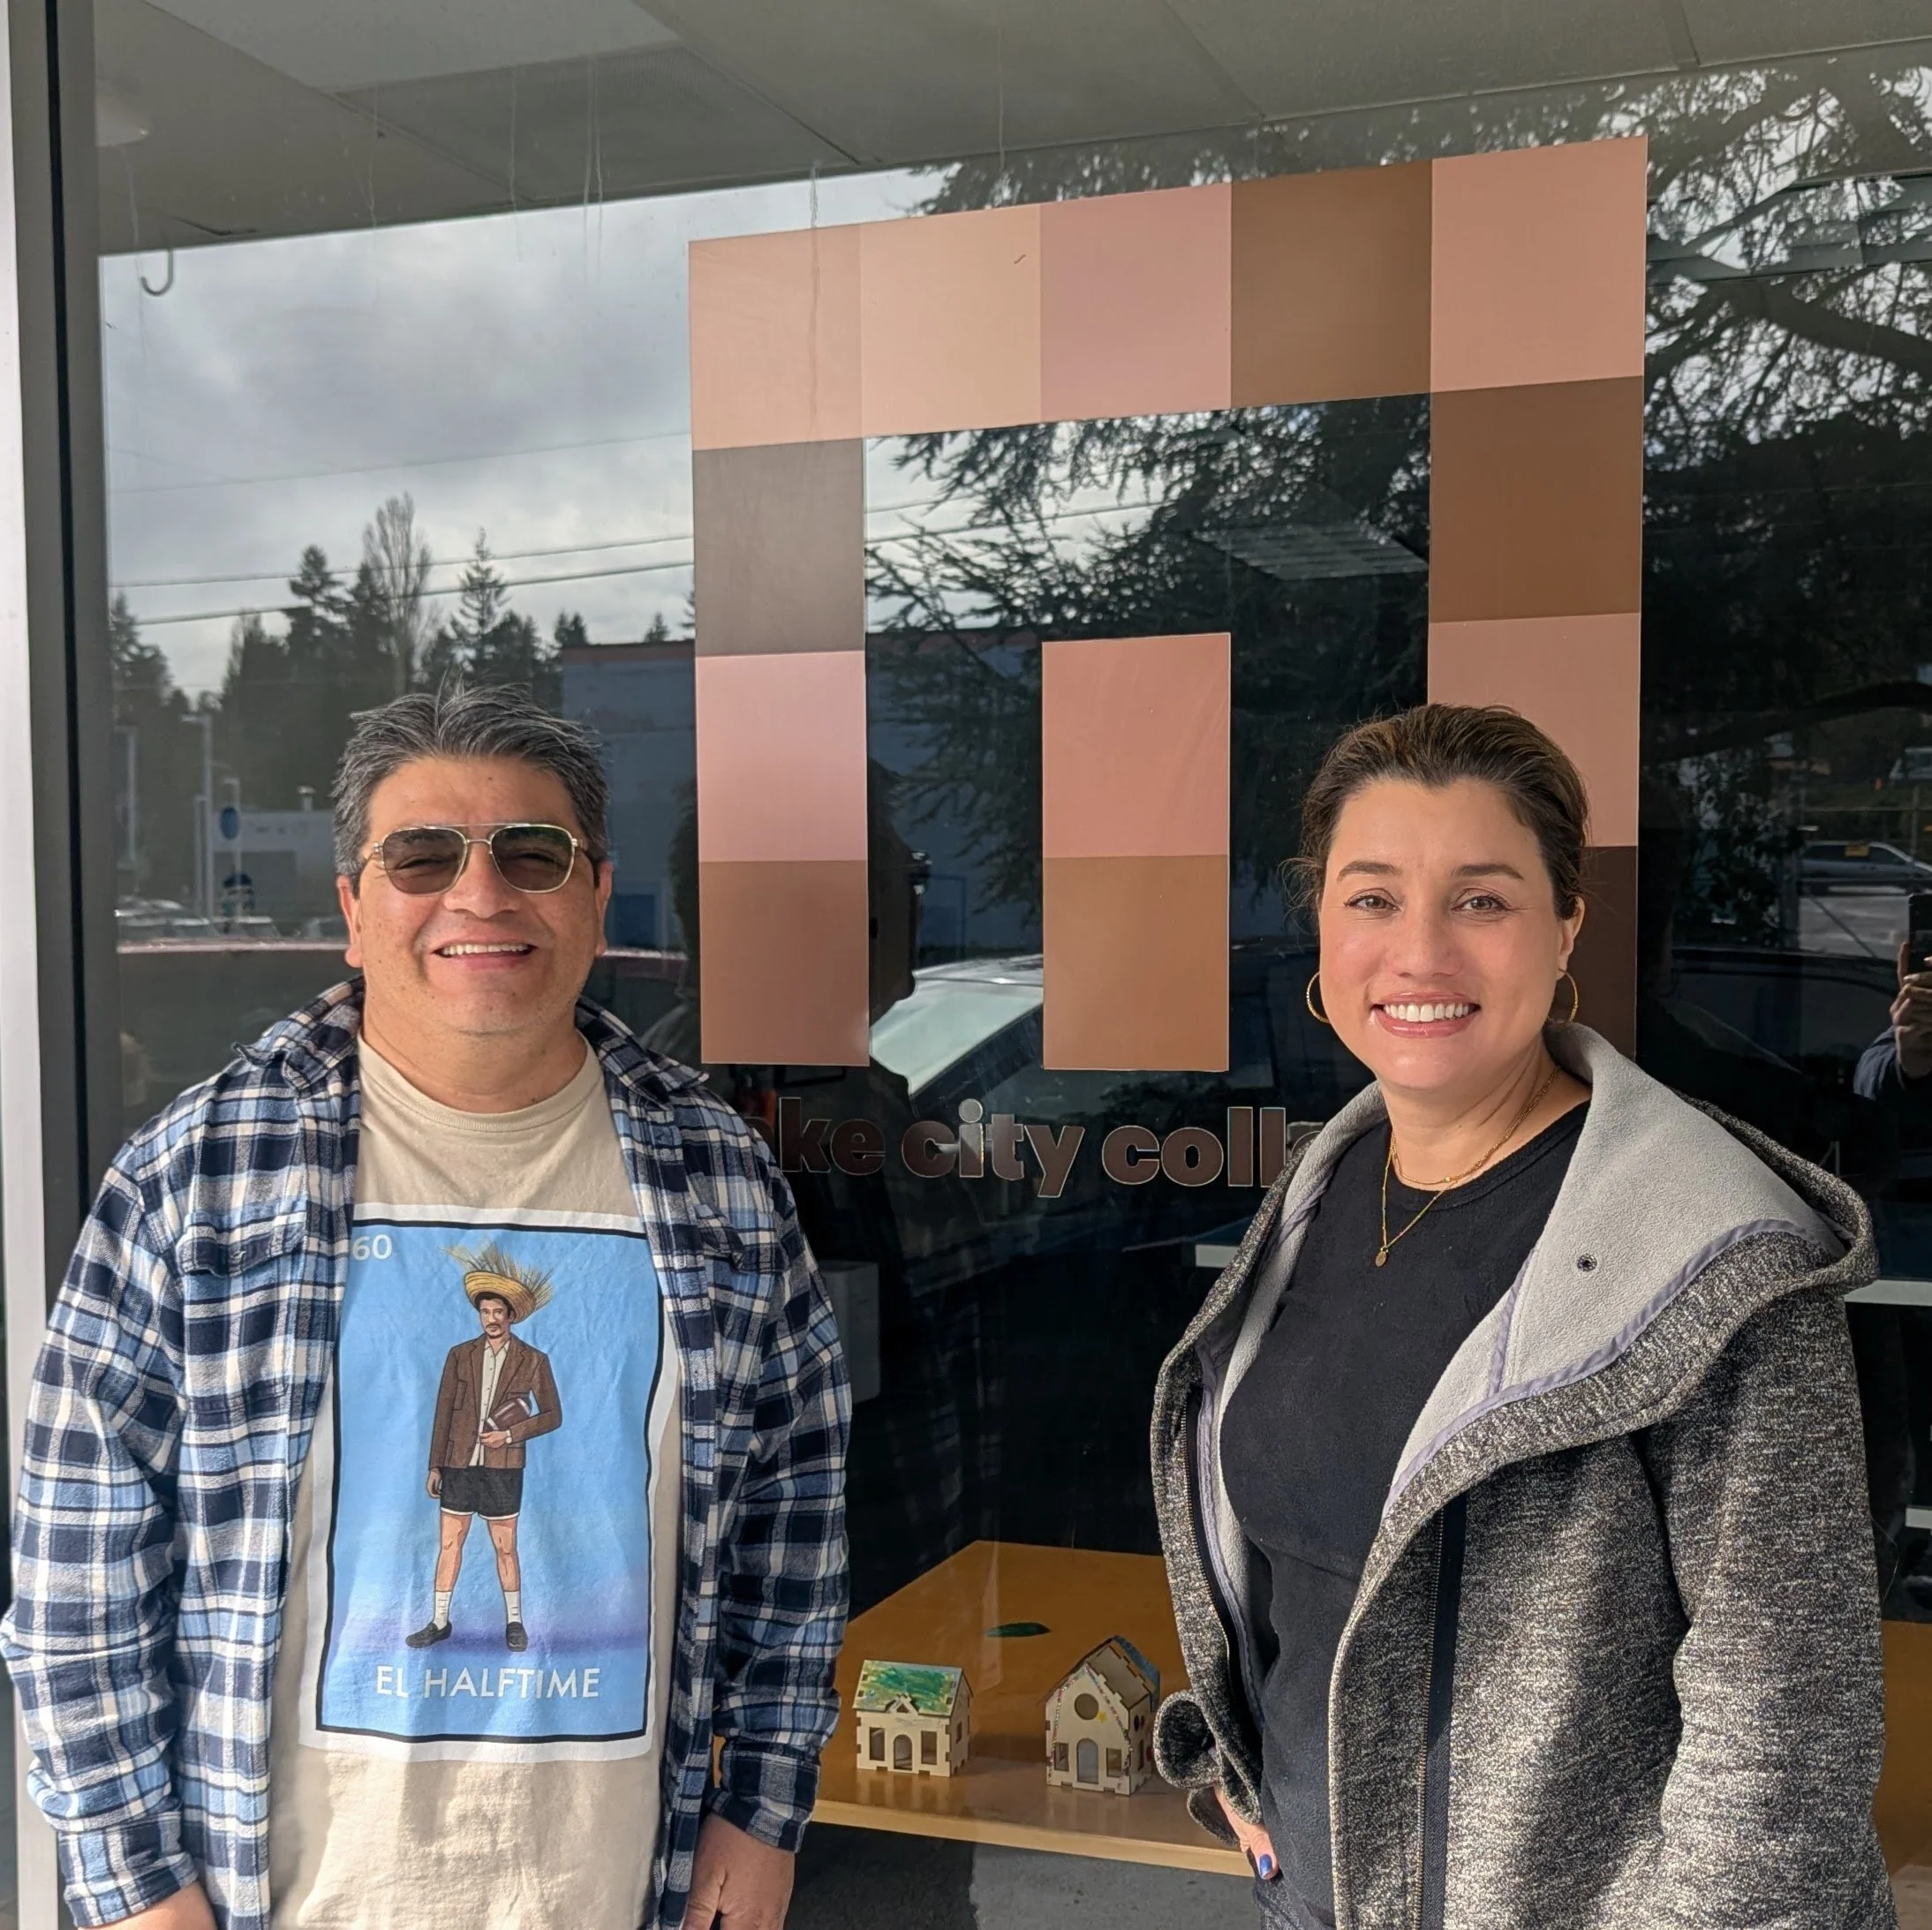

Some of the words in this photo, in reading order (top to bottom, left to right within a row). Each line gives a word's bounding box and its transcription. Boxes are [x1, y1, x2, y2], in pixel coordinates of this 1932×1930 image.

[901, 1097, 1085, 1199] city
[1101, 1105, 1322, 1188] coll
[351, 1233, 393, 1261] 60
[375, 1664, 409, 1698] EL
[424, 1666, 600, 1700] HALFTIME
